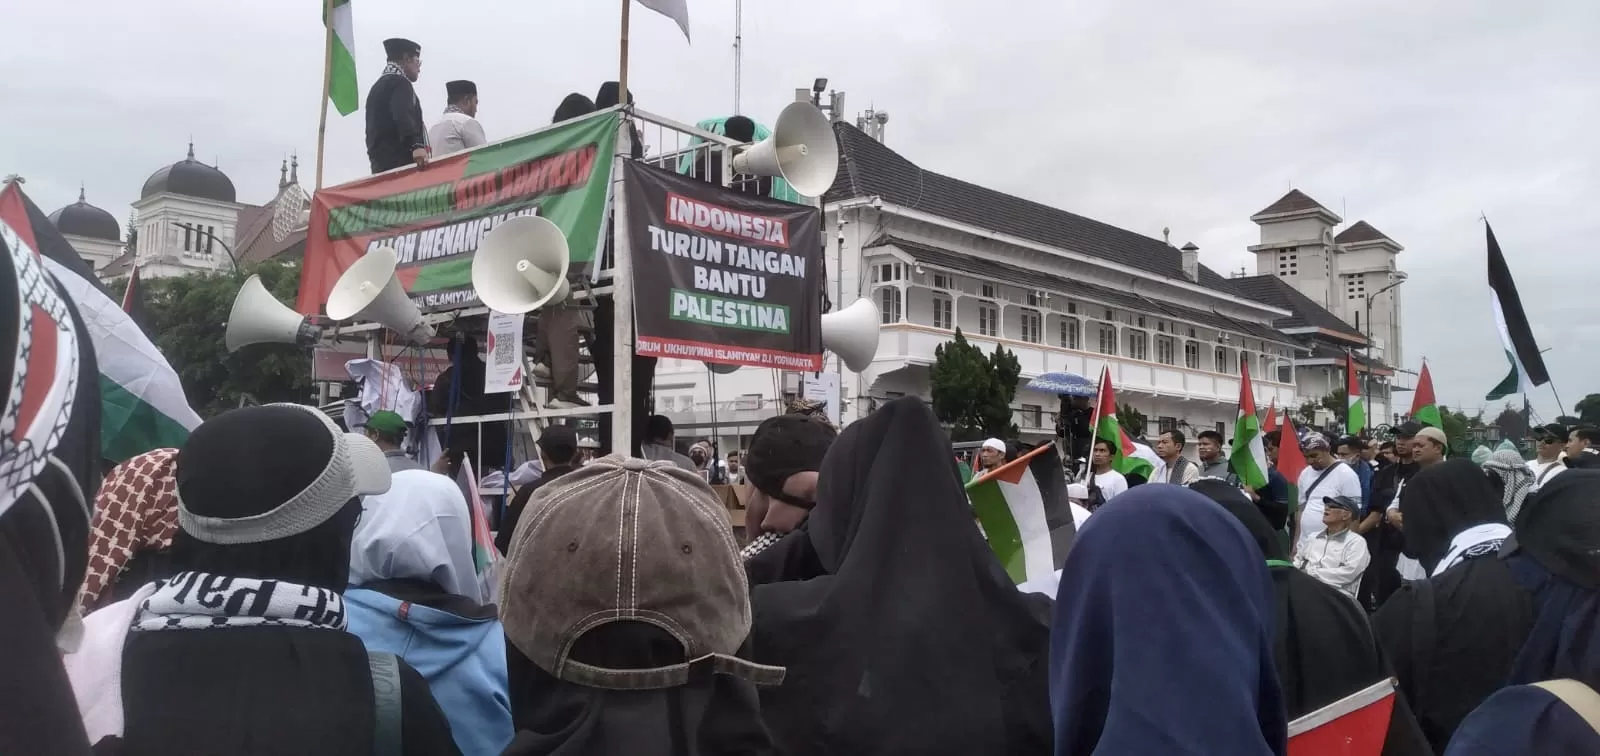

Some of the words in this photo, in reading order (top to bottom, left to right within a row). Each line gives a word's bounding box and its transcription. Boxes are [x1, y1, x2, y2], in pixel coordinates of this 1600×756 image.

[669, 197, 786, 244] INDONESIA
[647, 225, 722, 264] TURUN
[724, 243, 806, 279] TANGAN
[694, 265, 767, 298] BANTU
[673, 292, 787, 331] PALESTINA
[636, 340, 661, 353] ORUM
[663, 343, 714, 358] UKHUWWAH
[714, 349, 761, 363] ISLAMIYYAH
[170, 572, 277, 617] Pal
